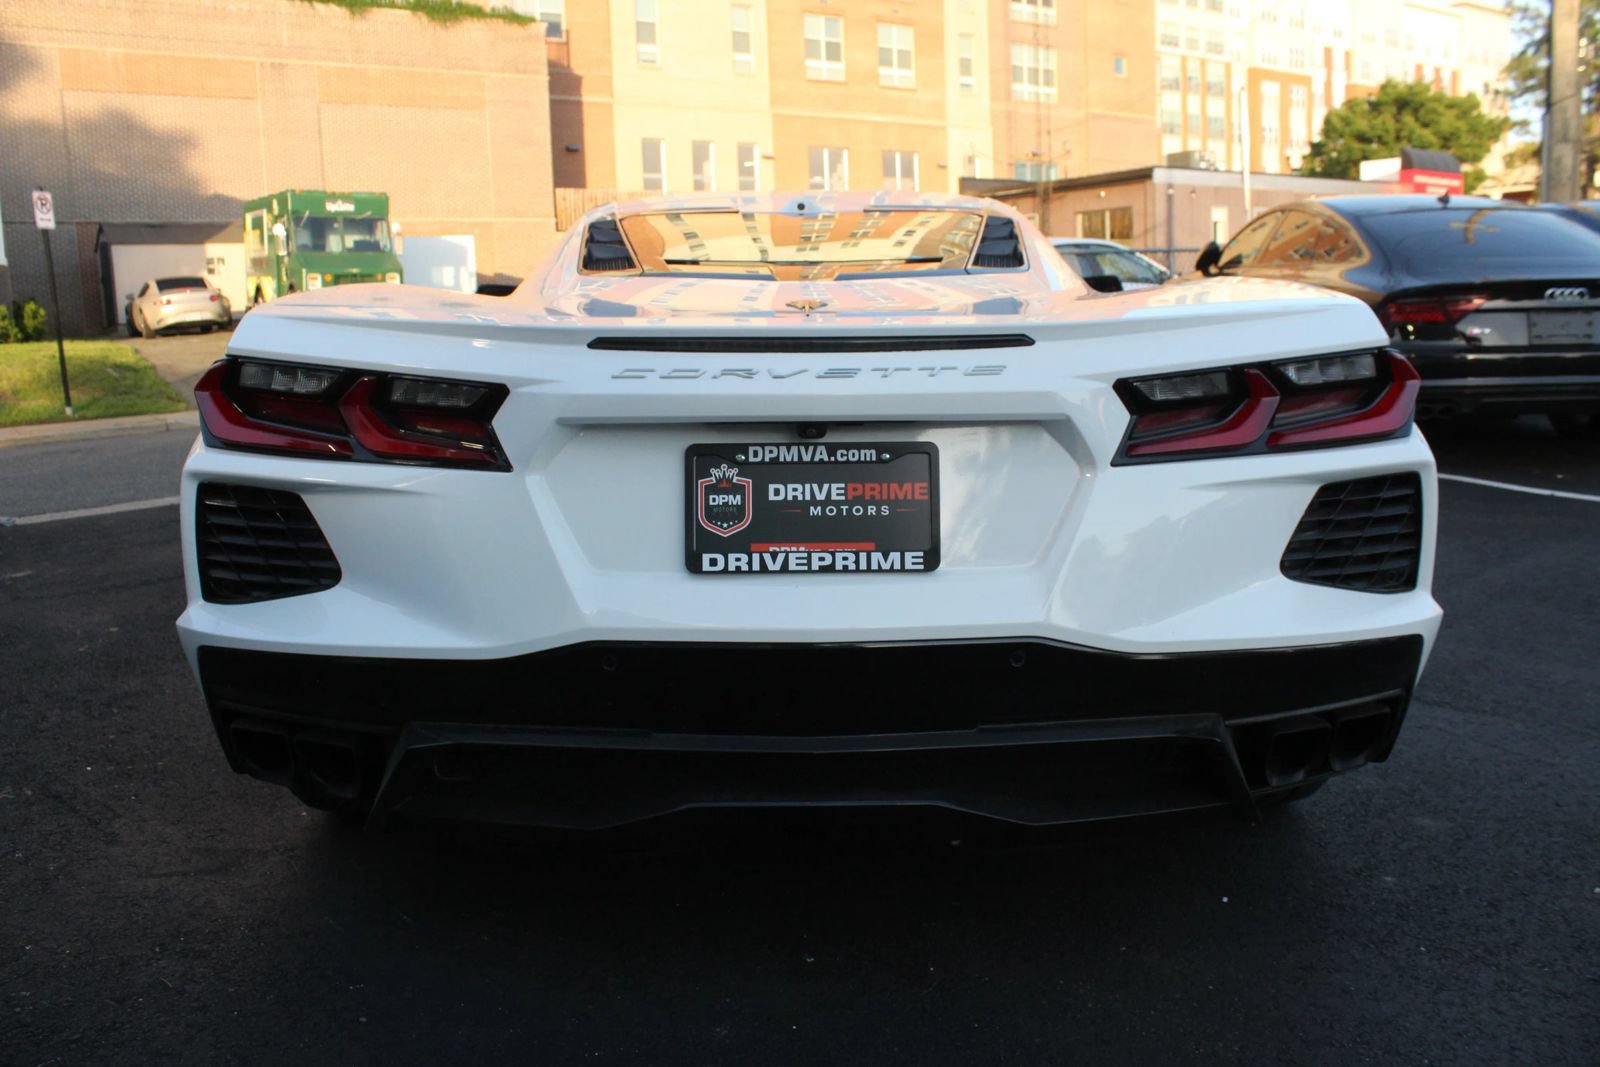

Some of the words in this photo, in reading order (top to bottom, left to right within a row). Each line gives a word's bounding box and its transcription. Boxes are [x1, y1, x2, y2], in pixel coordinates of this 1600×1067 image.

[611, 365, 1007, 379] CORVETTE
[748, 445, 877, 463] DPMVA.com
[768, 482, 929, 501] DRIVEPRIME
[708, 494, 742, 506] DPM
[809, 505, 890, 516] MOTORS
[701, 551, 925, 572] DRIVEPRIME
